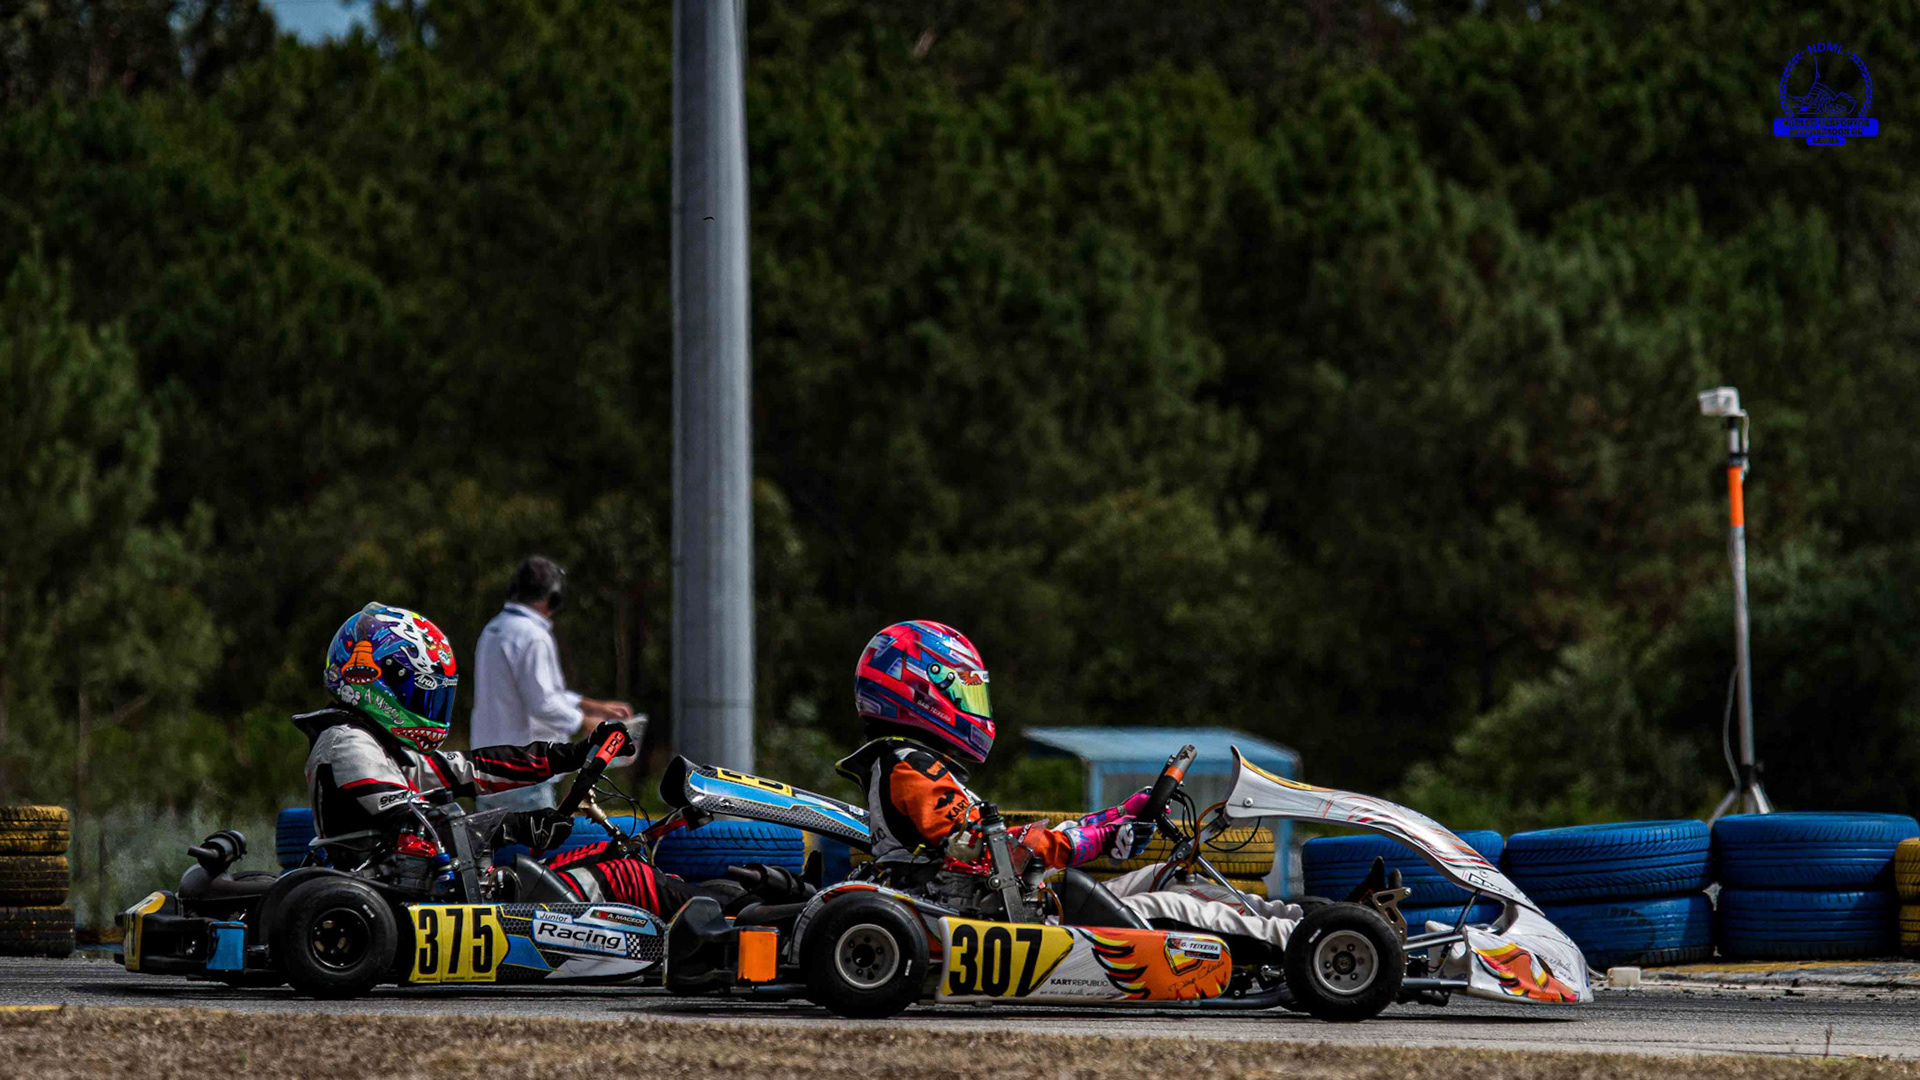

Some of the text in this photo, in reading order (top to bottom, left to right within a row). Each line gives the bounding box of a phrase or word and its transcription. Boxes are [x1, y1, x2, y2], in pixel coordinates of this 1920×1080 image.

[540, 912, 568, 922] Junior
[615, 915, 646, 925] MACEDO
[418, 907, 493, 975] 375
[537, 922, 621, 949] Racing
[1189, 942, 1219, 952] TEIXEIRA
[949, 924, 1043, 997] 307
